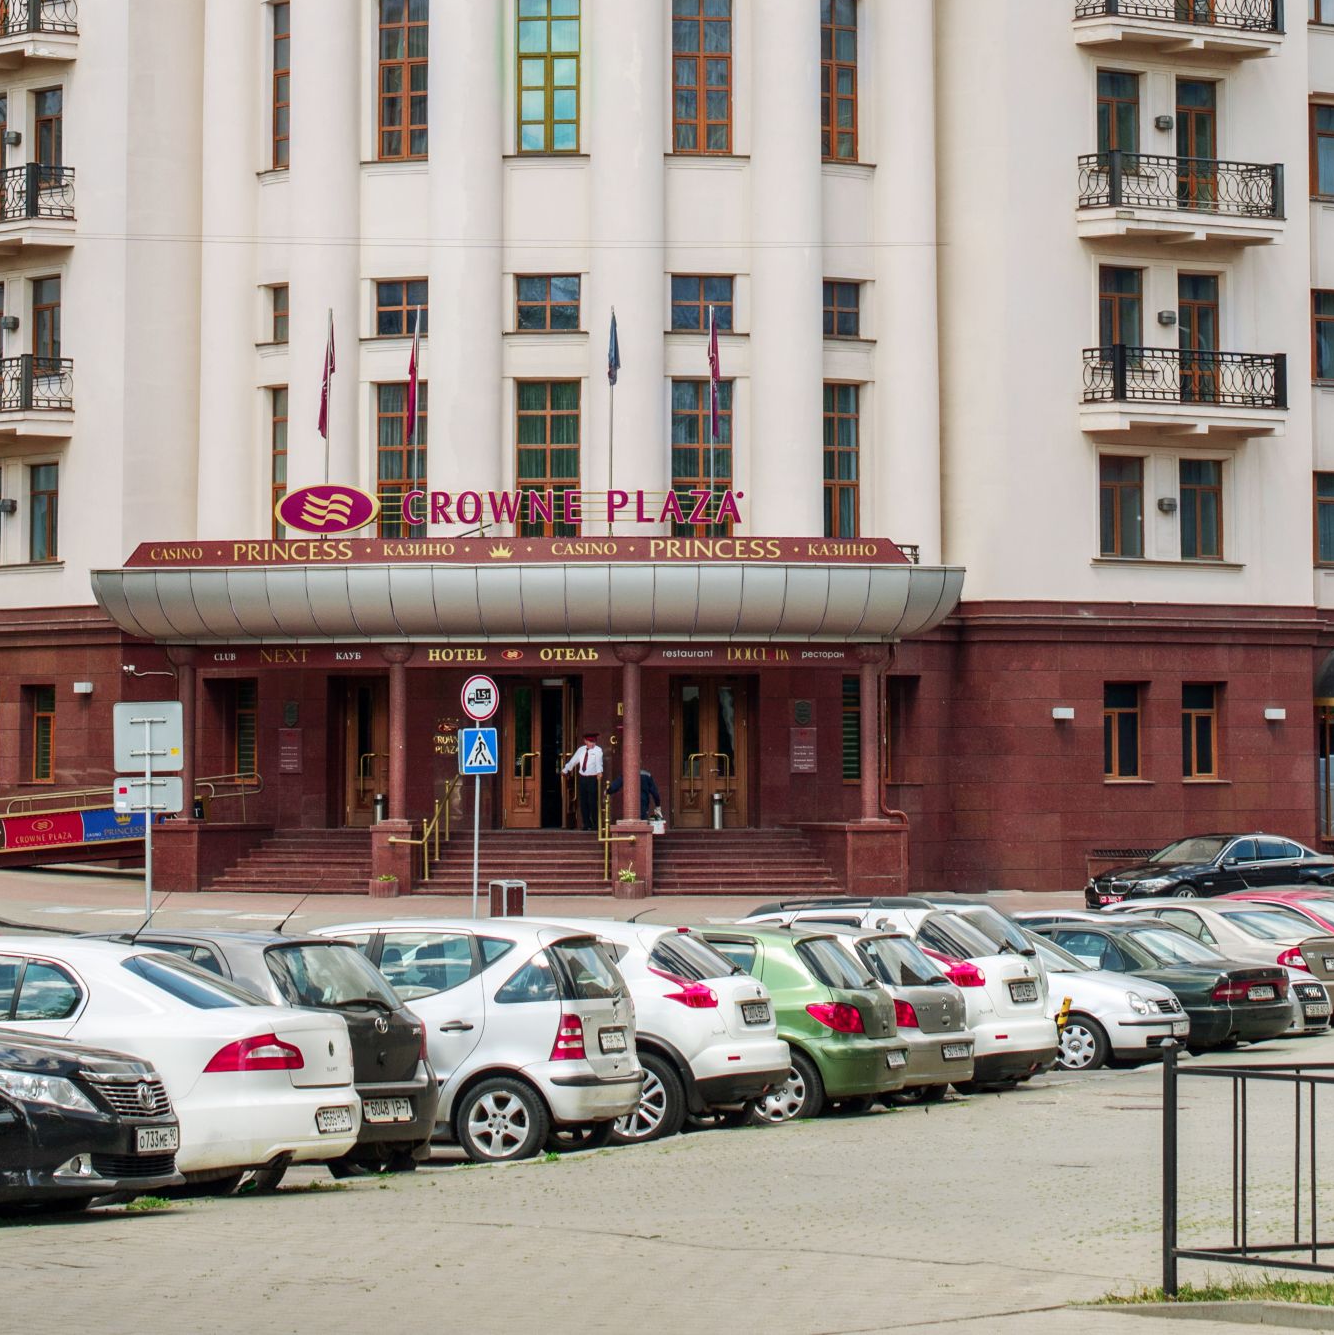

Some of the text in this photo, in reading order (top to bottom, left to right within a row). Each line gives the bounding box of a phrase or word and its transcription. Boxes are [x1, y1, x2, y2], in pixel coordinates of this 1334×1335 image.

[402, 489, 743, 526] CROWNE PLAZA
[150, 539, 878, 561] CASINO PRINCESS КАЗИНО CASINO PRINCESS КАЗИНО
[213, 648, 362, 663] CLUB NEXT КЛУБ
[428, 647, 599, 662] HOTEL ОТЕЛЬ
[662, 649, 714, 658] restaurant
[727, 646, 771, 661] DOLCE
[801, 650, 845, 660] ресторан
[15, 831, 73, 844] CROWNE PLAZA
[103, 824, 147, 837] PRINCESS
[370, 1100, 409, 1116] 6048 IP-7
